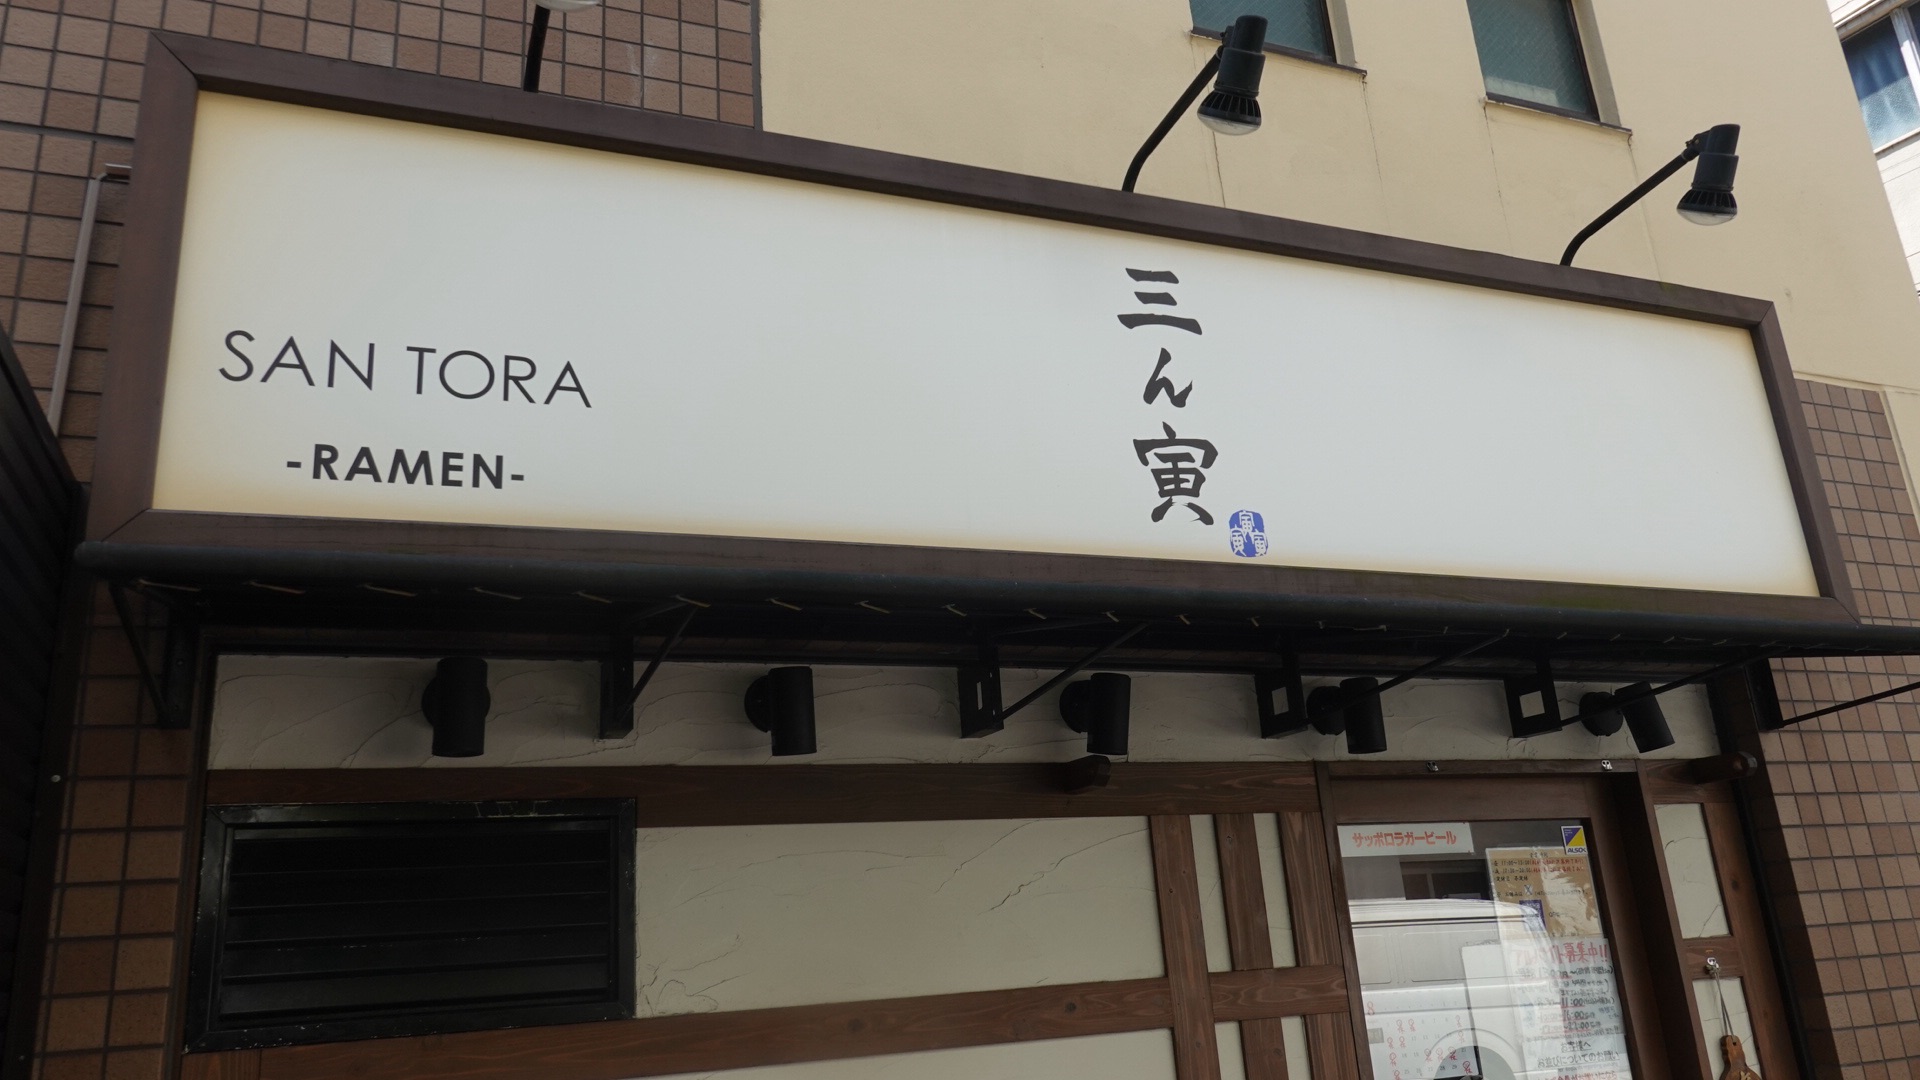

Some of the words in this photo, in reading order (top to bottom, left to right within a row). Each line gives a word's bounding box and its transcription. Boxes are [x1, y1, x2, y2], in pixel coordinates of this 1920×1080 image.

[218, 329, 375, 395] SAN
[406, 345, 592, 408] TORA
[1117, 267, 1219, 527] 三ん寅
[286, 443, 525, 490] -RAMEN-
[1352, 831, 1457, 848] サッポロラガービール
